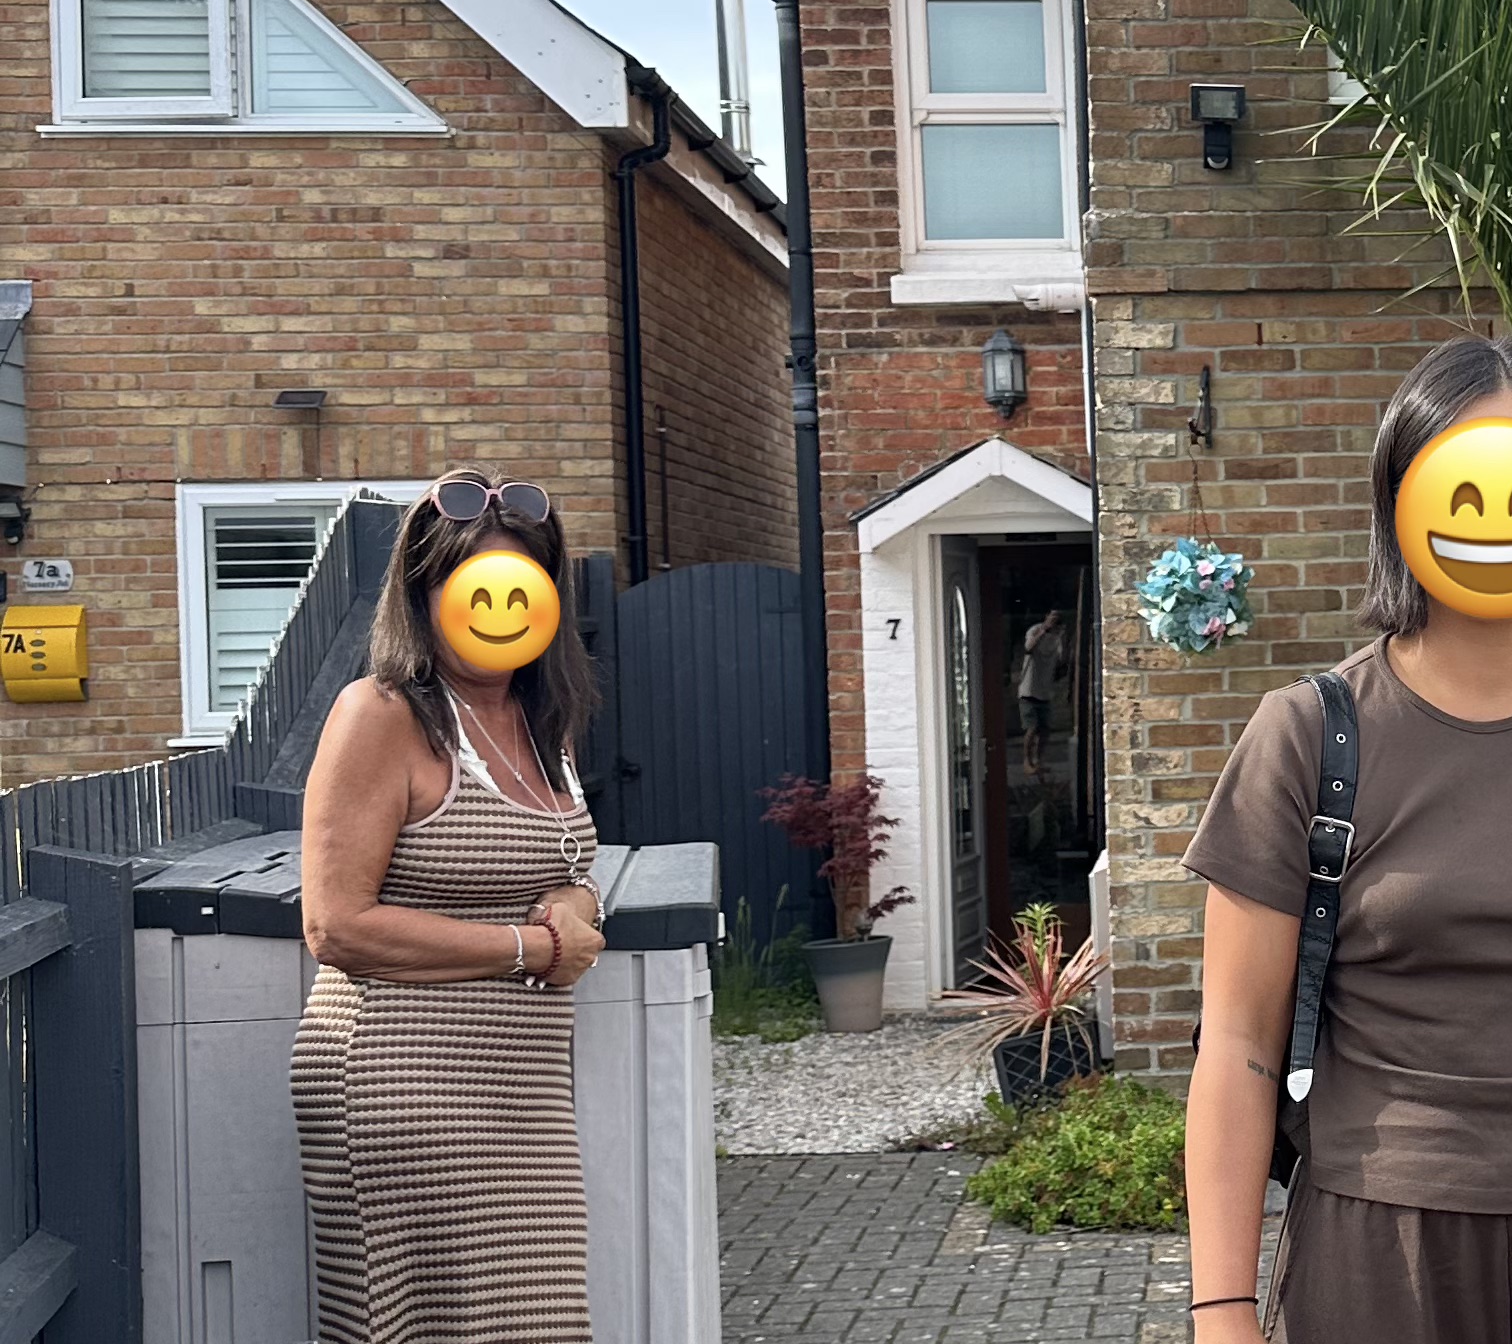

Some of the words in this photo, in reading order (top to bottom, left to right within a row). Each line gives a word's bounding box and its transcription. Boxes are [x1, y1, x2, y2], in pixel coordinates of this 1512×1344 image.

[33, 561, 60, 578] 7a
[885, 618, 902, 640] 7
[2, 633, 26, 654] 7A
